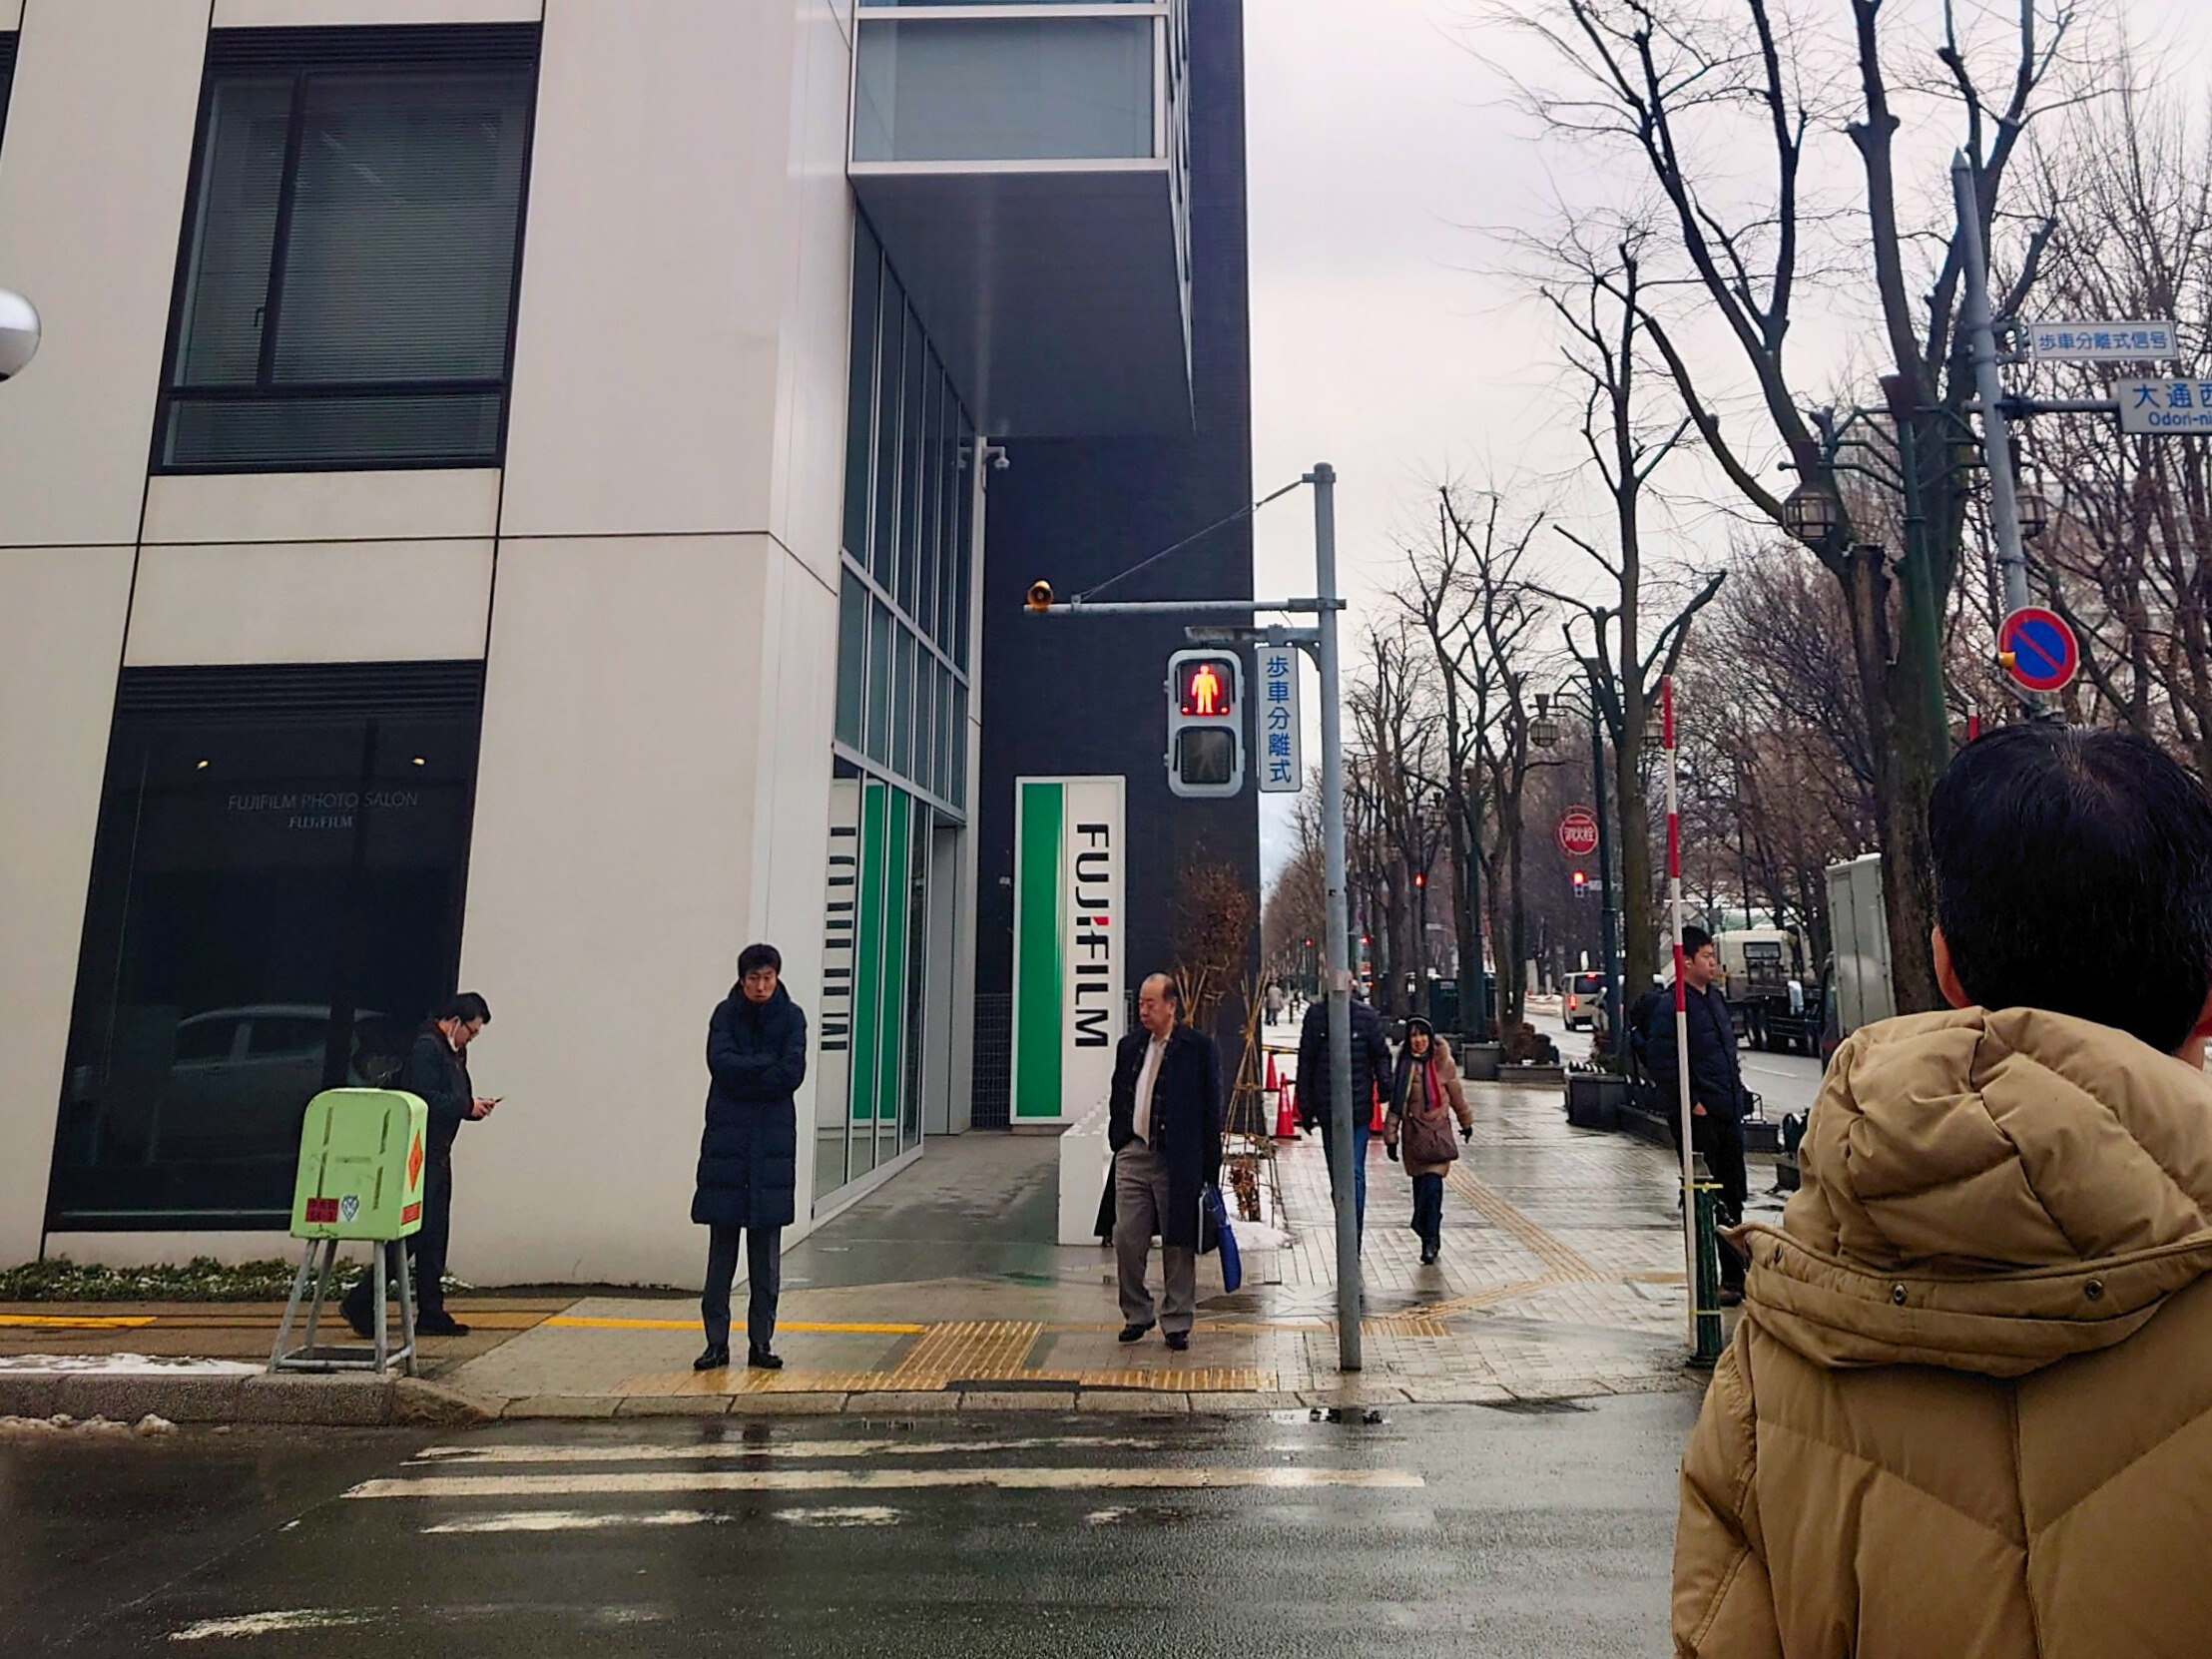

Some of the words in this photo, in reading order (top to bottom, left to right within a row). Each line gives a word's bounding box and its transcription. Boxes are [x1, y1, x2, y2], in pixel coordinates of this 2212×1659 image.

[2039, 331, 2167, 351] 歩車分離式信号
[1267, 655, 1291, 784] 歩車分離式
[228, 795, 295, 811] FUJIFILM
[301, 793, 358, 809] PHOTO
[364, 791, 418, 807] SALON
[1075, 824, 1109, 1046] FUJIFILM
